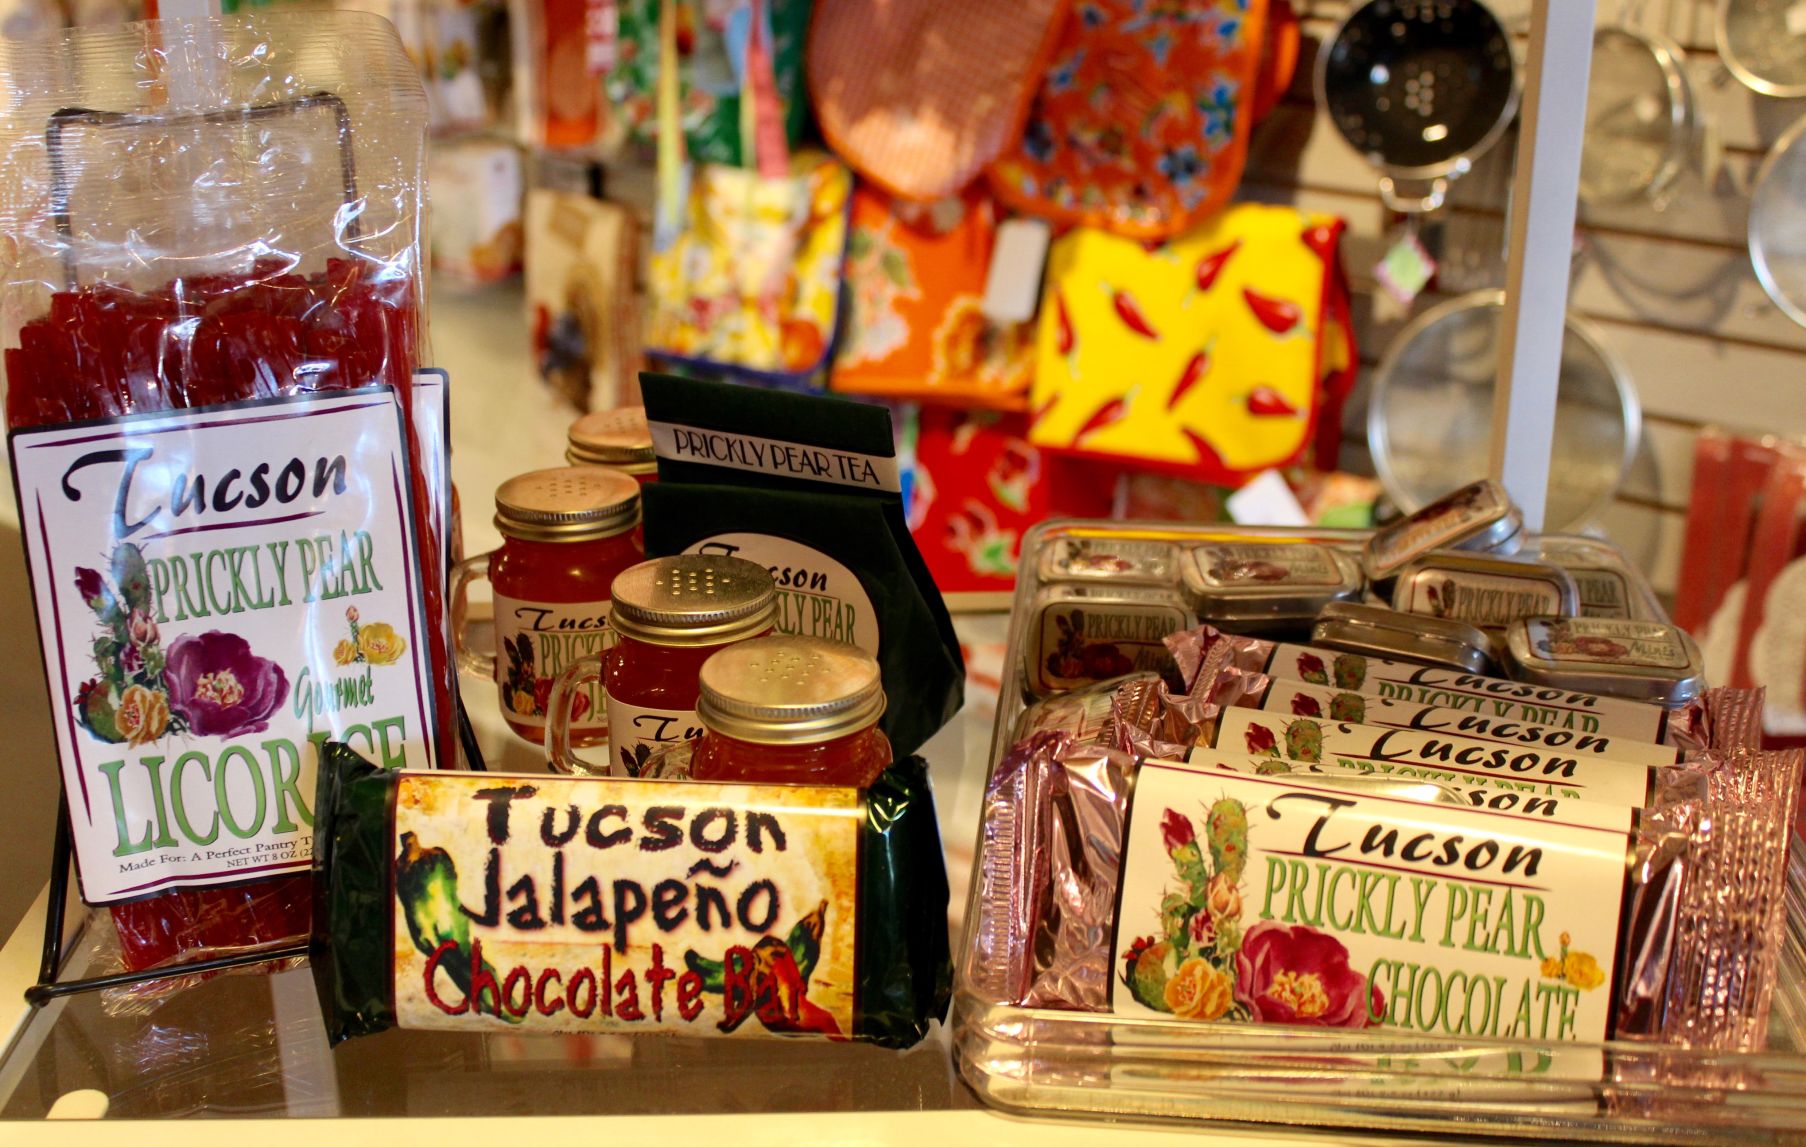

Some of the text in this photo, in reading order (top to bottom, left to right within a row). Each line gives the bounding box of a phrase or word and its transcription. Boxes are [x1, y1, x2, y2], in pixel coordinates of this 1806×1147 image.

[61, 447, 347, 539] Tucson
[673, 428, 880, 485] PRICKLY PEAR TEA
[151, 528, 384, 623] PRICKLY PEAR
[812, 597, 856, 645] PEAR
[1086, 613, 1143, 640] PRICKLY
[293, 664, 375, 734] Gourmet
[99, 714, 406, 858] LICORE
[470, 785, 787, 855] Tucson
[119, 858, 155, 874] Made
[160, 853, 187, 865] For:
[191, 851, 203, 862] A
[206, 847, 250, 862] Perfect
[256, 838, 299, 855] Pantry
[226, 859, 249, 869] NET
[251, 854, 270, 866] WT
[272, 853, 279, 862] 8
[280, 850, 297, 861] OZ
[1266, 792, 1545, 877] Tucson
[459, 846, 782, 954] Jalapeño
[1258, 856, 1549, 961] PRICKLY PEAR
[424, 937, 807, 1023] Chocolate Bar
[1364, 957, 1580, 1041] CHOCOLATE
